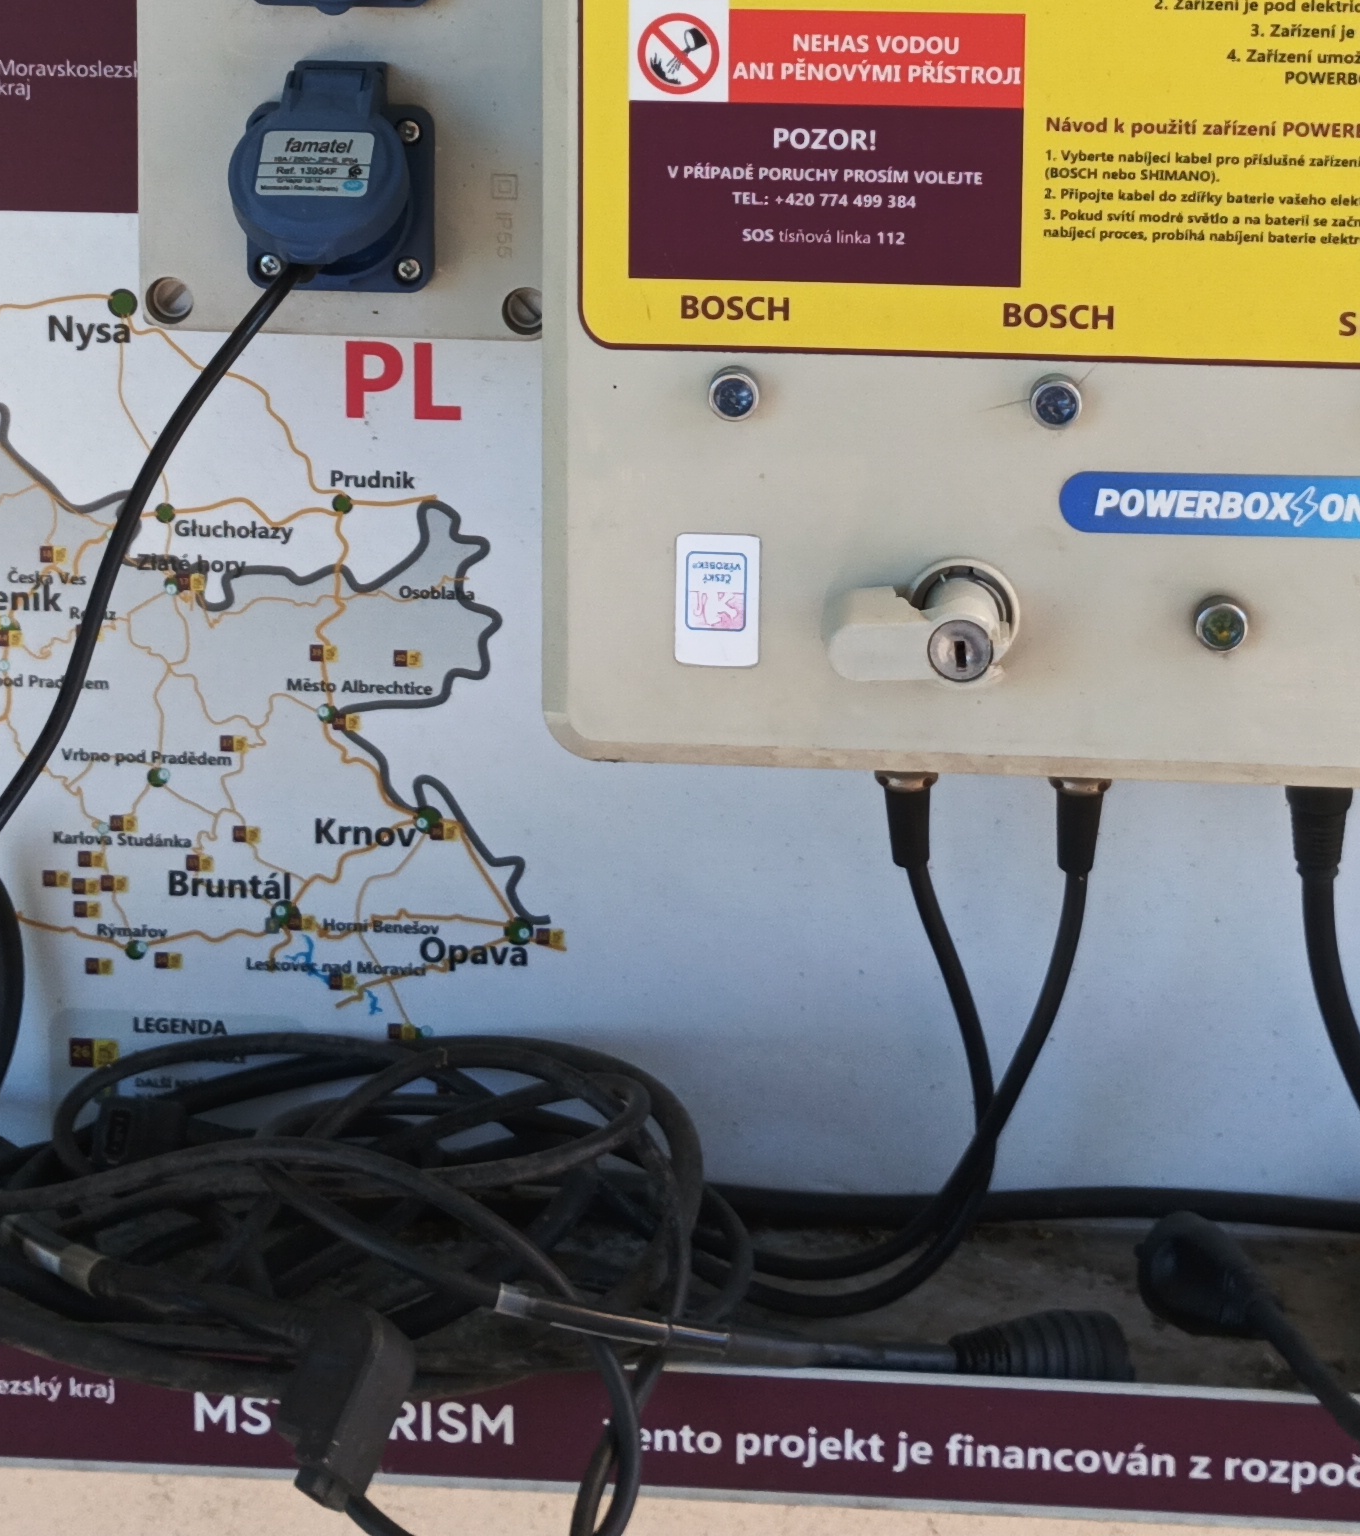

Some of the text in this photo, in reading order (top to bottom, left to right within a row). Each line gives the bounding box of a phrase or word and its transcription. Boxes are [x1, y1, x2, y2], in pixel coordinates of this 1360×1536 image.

[792, 33, 960, 55] NEHAS VODOU
[732, 58, 1021, 85] ANI PĚNOVÝMI PŘÍSTROJI
[284, 137, 354, 154] famatel
[773, 127, 876, 151] POZOR!
[667, 162, 983, 186] V PŘÍPADĚ PORUCHY PROSÍM VOLEJTE
[731, 191, 917, 209] TEL.: +420 774 499 384
[742, 227, 905, 246] SOS tísňová linka 112
[680, 294, 790, 322] BOSCH
[1002, 302, 1115, 330] BOSCH
[48, 315, 132, 350] Nysa
[344, 340, 463, 421] PL
[330, 470, 416, 490] Prudnik
[1094, 488, 1294, 522] POWERBOX
[174, 520, 293, 544] Głuchołazy
[398, 586, 475, 602] Osoblaha
[286, 678, 433, 697] Město Albrechtice
[315, 818, 417, 847] Krnov
[168, 870, 291, 900] Bruntál
[420, 937, 529, 972] Opava
[133, 1016, 228, 1036] LEGENDA
[68, 1376, 116, 1406] kraj
[736, 1426, 885, 1469] projekt
[892, 1430, 933, 1473] je
[945, 1432, 1176, 1478] financován
[1188, 1455, 1212, 1480] z
